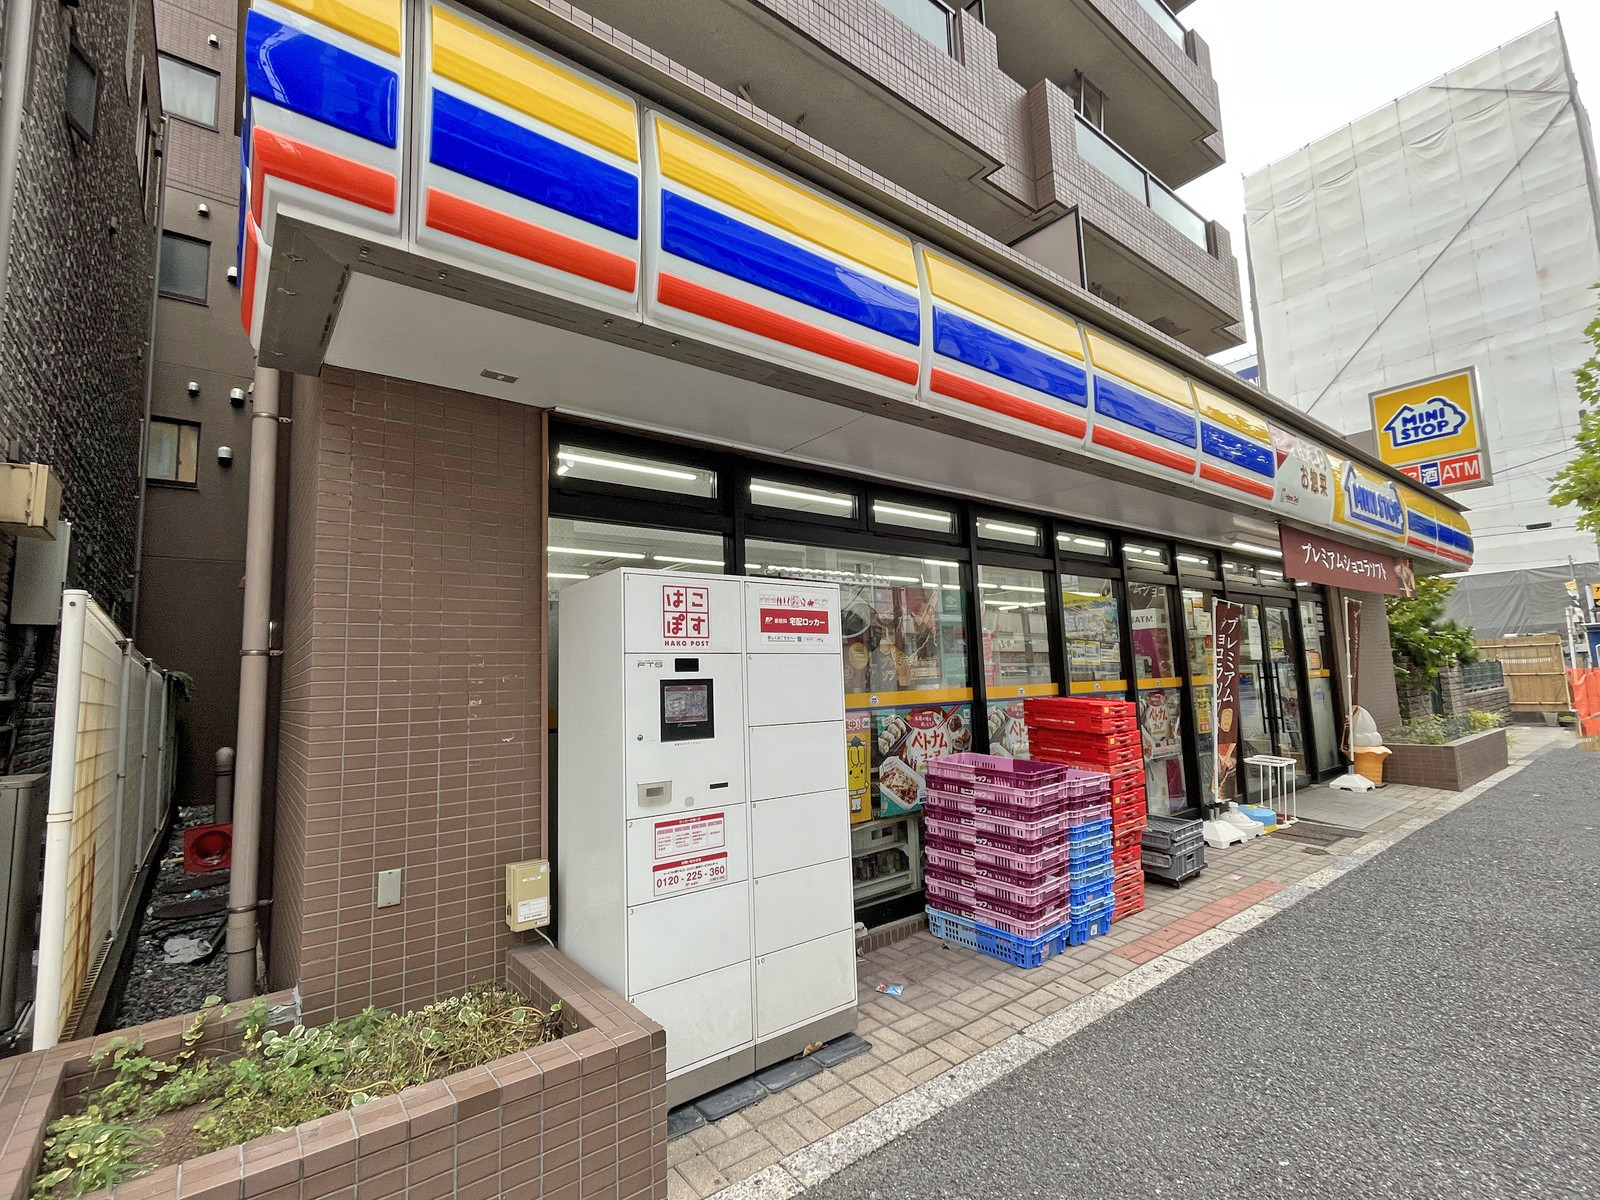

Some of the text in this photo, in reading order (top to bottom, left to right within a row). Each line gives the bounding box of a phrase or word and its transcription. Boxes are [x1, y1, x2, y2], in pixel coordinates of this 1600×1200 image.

[1402, 407, 1446, 427] MINI
[1401, 420, 1449, 440] STOP
[1421, 467, 1438, 485] 酒
[1442, 460, 1479, 480] ATM
[1352, 482, 1403, 525] MINI STOP
[1301, 542, 1387, 580] プレミアムショコラソフト
[789, 617, 826, 627] 宅配ロッカー
[1223, 617, 1239, 703] プレミアム
[1149, 707, 1168, 721] ベトナム
[911, 730, 948, 751] ベトナム
